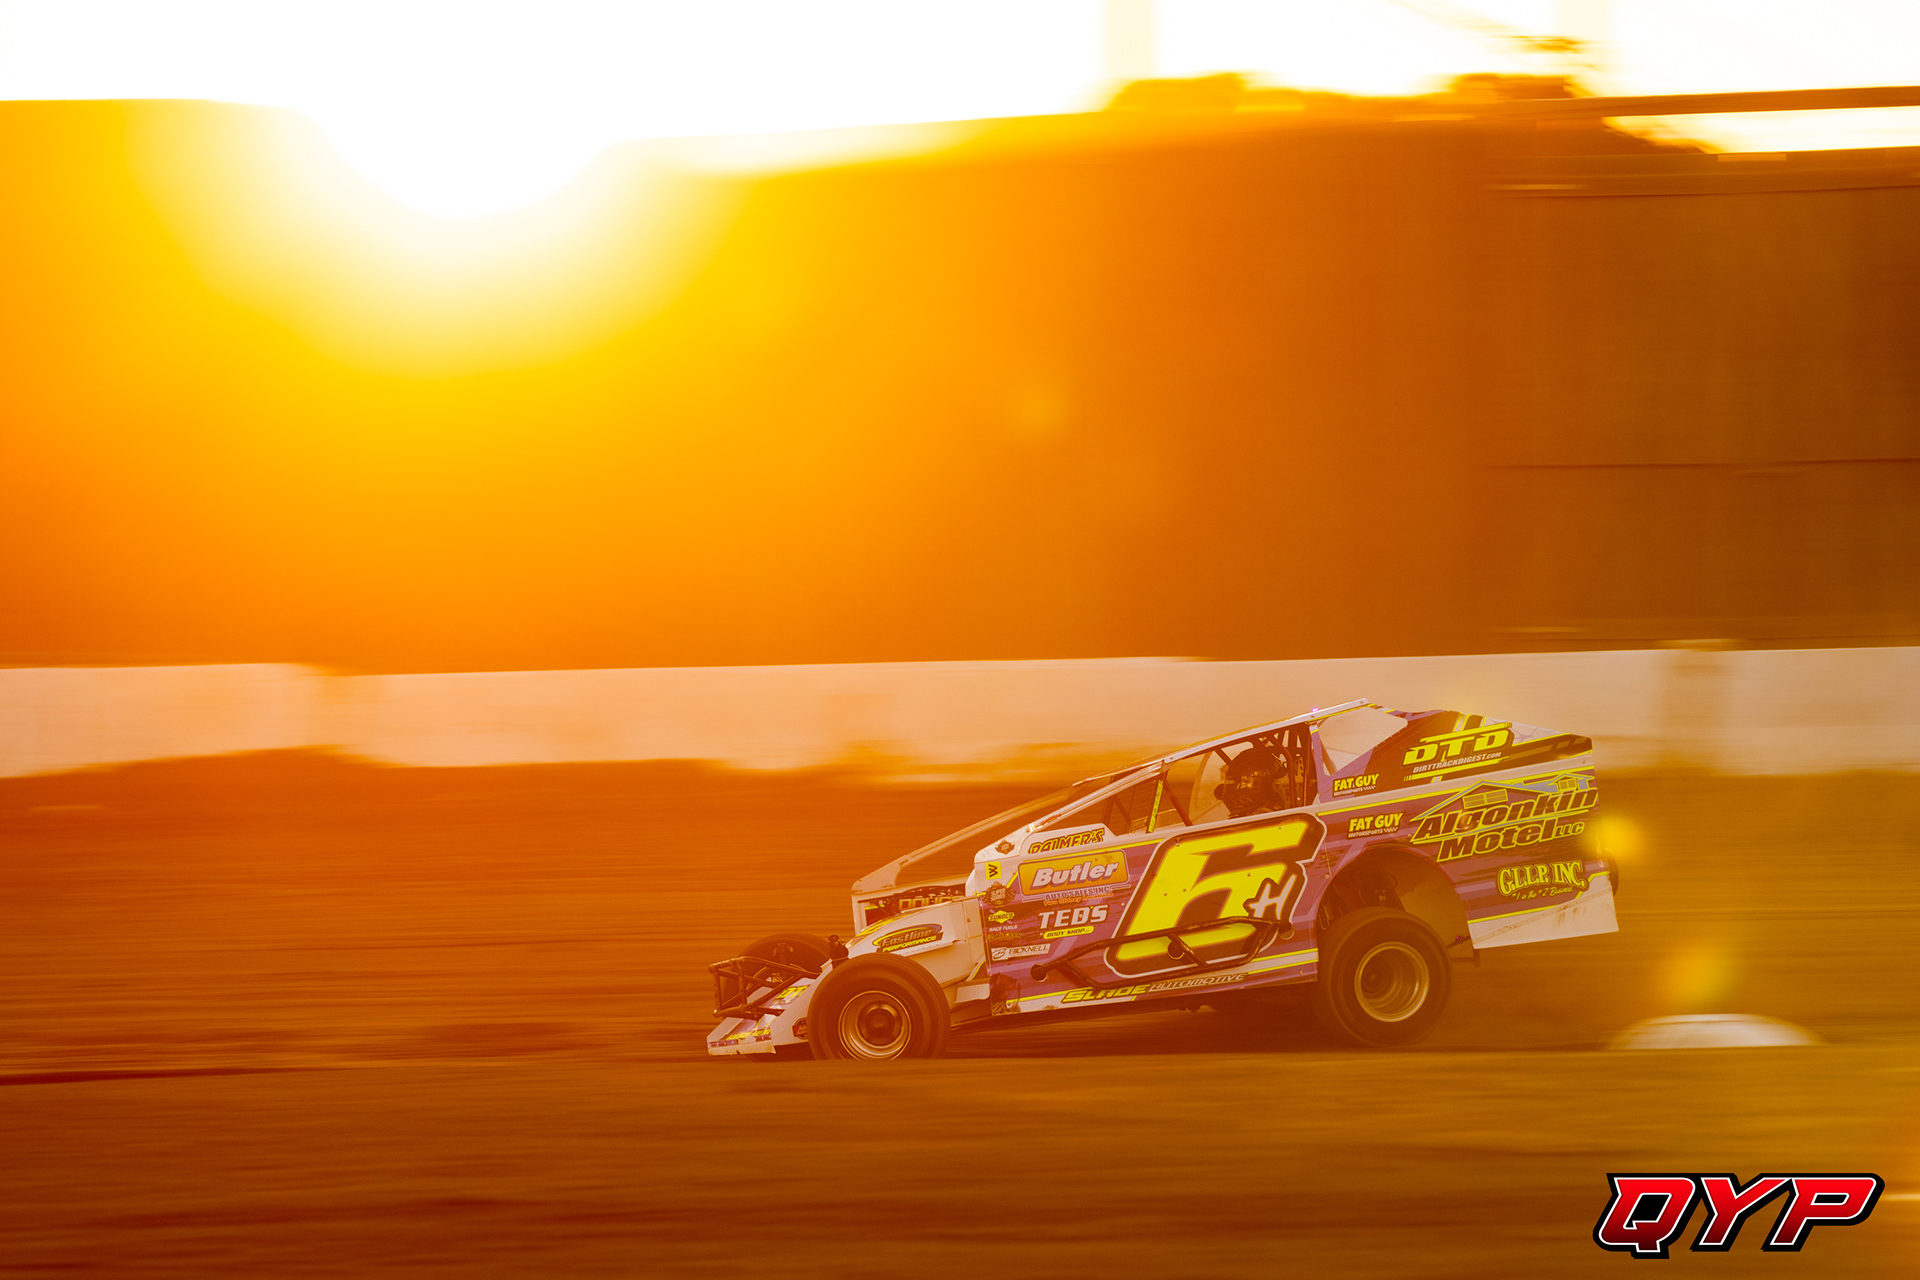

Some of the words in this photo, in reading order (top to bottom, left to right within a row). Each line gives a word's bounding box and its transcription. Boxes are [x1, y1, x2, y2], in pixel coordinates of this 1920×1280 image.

[1403, 729, 1510, 766] DTD
[1412, 752, 1502, 774] DIRTTRACKDIGEST.com
[1334, 777, 1354, 791] FAT
[1355, 773, 1380, 788] GUY
[1349, 816, 1374, 832] FAT
[1374, 812, 1404, 829] GUY
[1410, 788, 1599, 843] Algonkin
[1028, 828, 1105, 854] PALMER'S
[1348, 828, 1384, 839] MOTORSPORTS
[1437, 817, 1559, 863] Motel
[1554, 821, 1586, 838] LLC
[1031, 860, 1119, 889] Butler
[1552, 860, 1585, 887] INC.
[1045, 892, 1068, 901] AUTO
[1069, 888, 1094, 898] SALES
[1095, 885, 1111, 894] INC
[989, 911, 1015, 921] SUNOCO
[1039, 904, 1109, 929] TED'S
[881, 927, 933, 948] Fastline
[882, 935, 937, 953] PERFORMANCE
[1046, 930, 1065, 938] BODY
[1008, 944, 1050, 955] BICKNELL
[1061, 984, 1150, 1003] SLADE
[1149, 973, 1248, 993] AUTOMOTIVE
